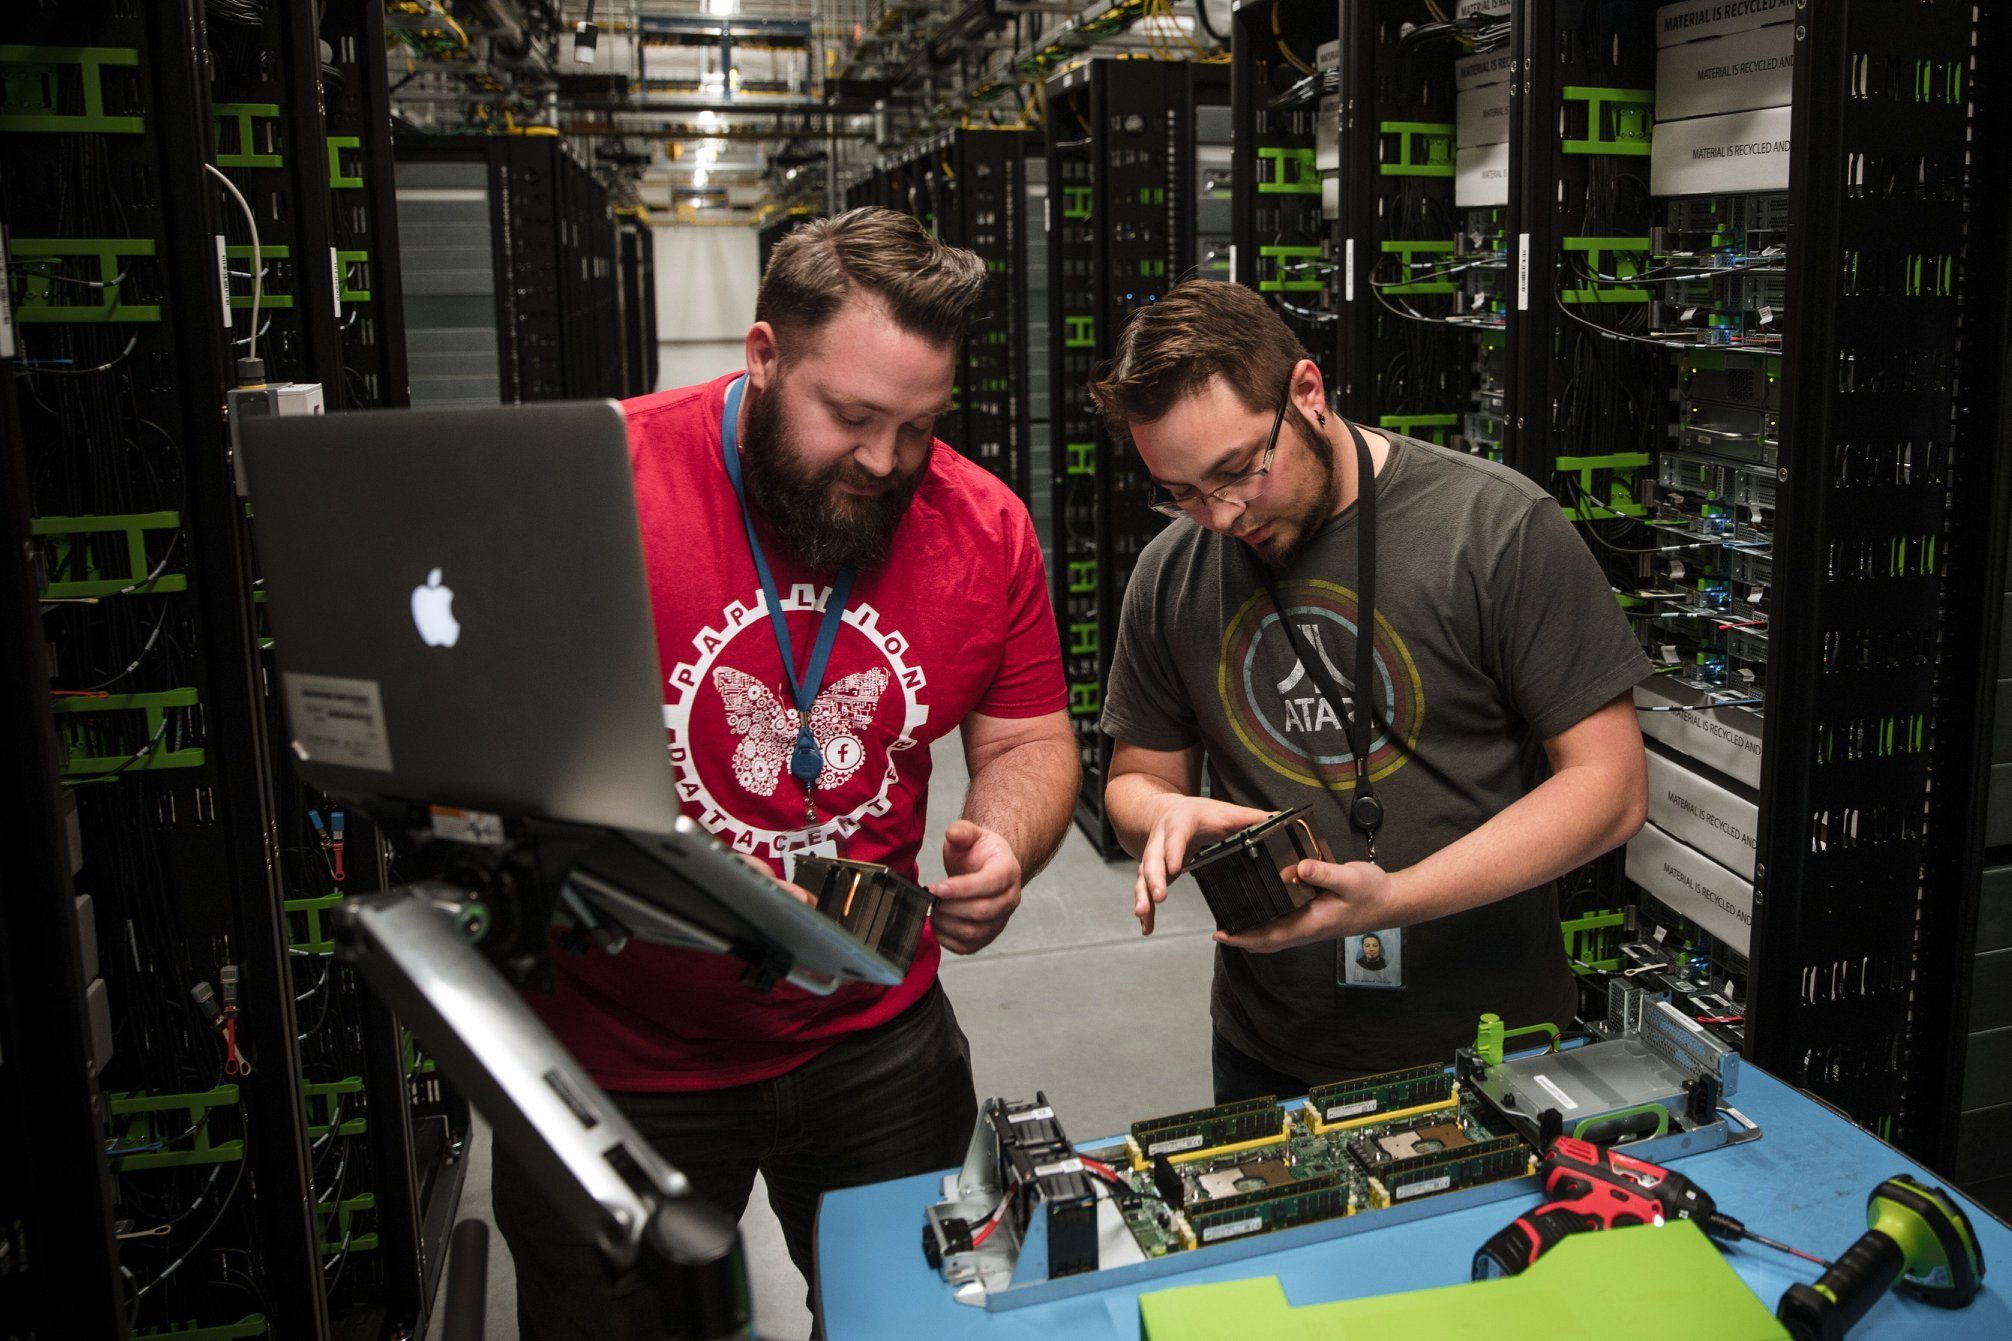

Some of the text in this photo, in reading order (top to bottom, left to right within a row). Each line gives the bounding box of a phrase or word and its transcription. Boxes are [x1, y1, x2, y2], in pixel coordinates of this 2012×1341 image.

[1663, 9, 1710, 31] MATERIAL
[1713, 6, 1722, 20] IS
[1725, 0, 1777, 19] RECYCLED
[1697, 65, 1730, 80] MATERIAL
[1732, 64, 1739, 75] IS
[1741, 57, 1777, 74] RECYCLED
[1692, 140, 1791, 159] MATERIAL IS RECYCLED AND
[678, 589, 920, 688] PAPLION
[1285, 697, 1375, 732] ATA
[1702, 720, 1709, 731] IS
[1710, 723, 1744, 748] RECYCLED
[1745, 740, 1761, 756] AND
[1668, 792, 1757, 849] MATERIAL IS RECYCLED AND
[1664, 862, 1752, 926] MATERIAL IS RECYCLED AND
